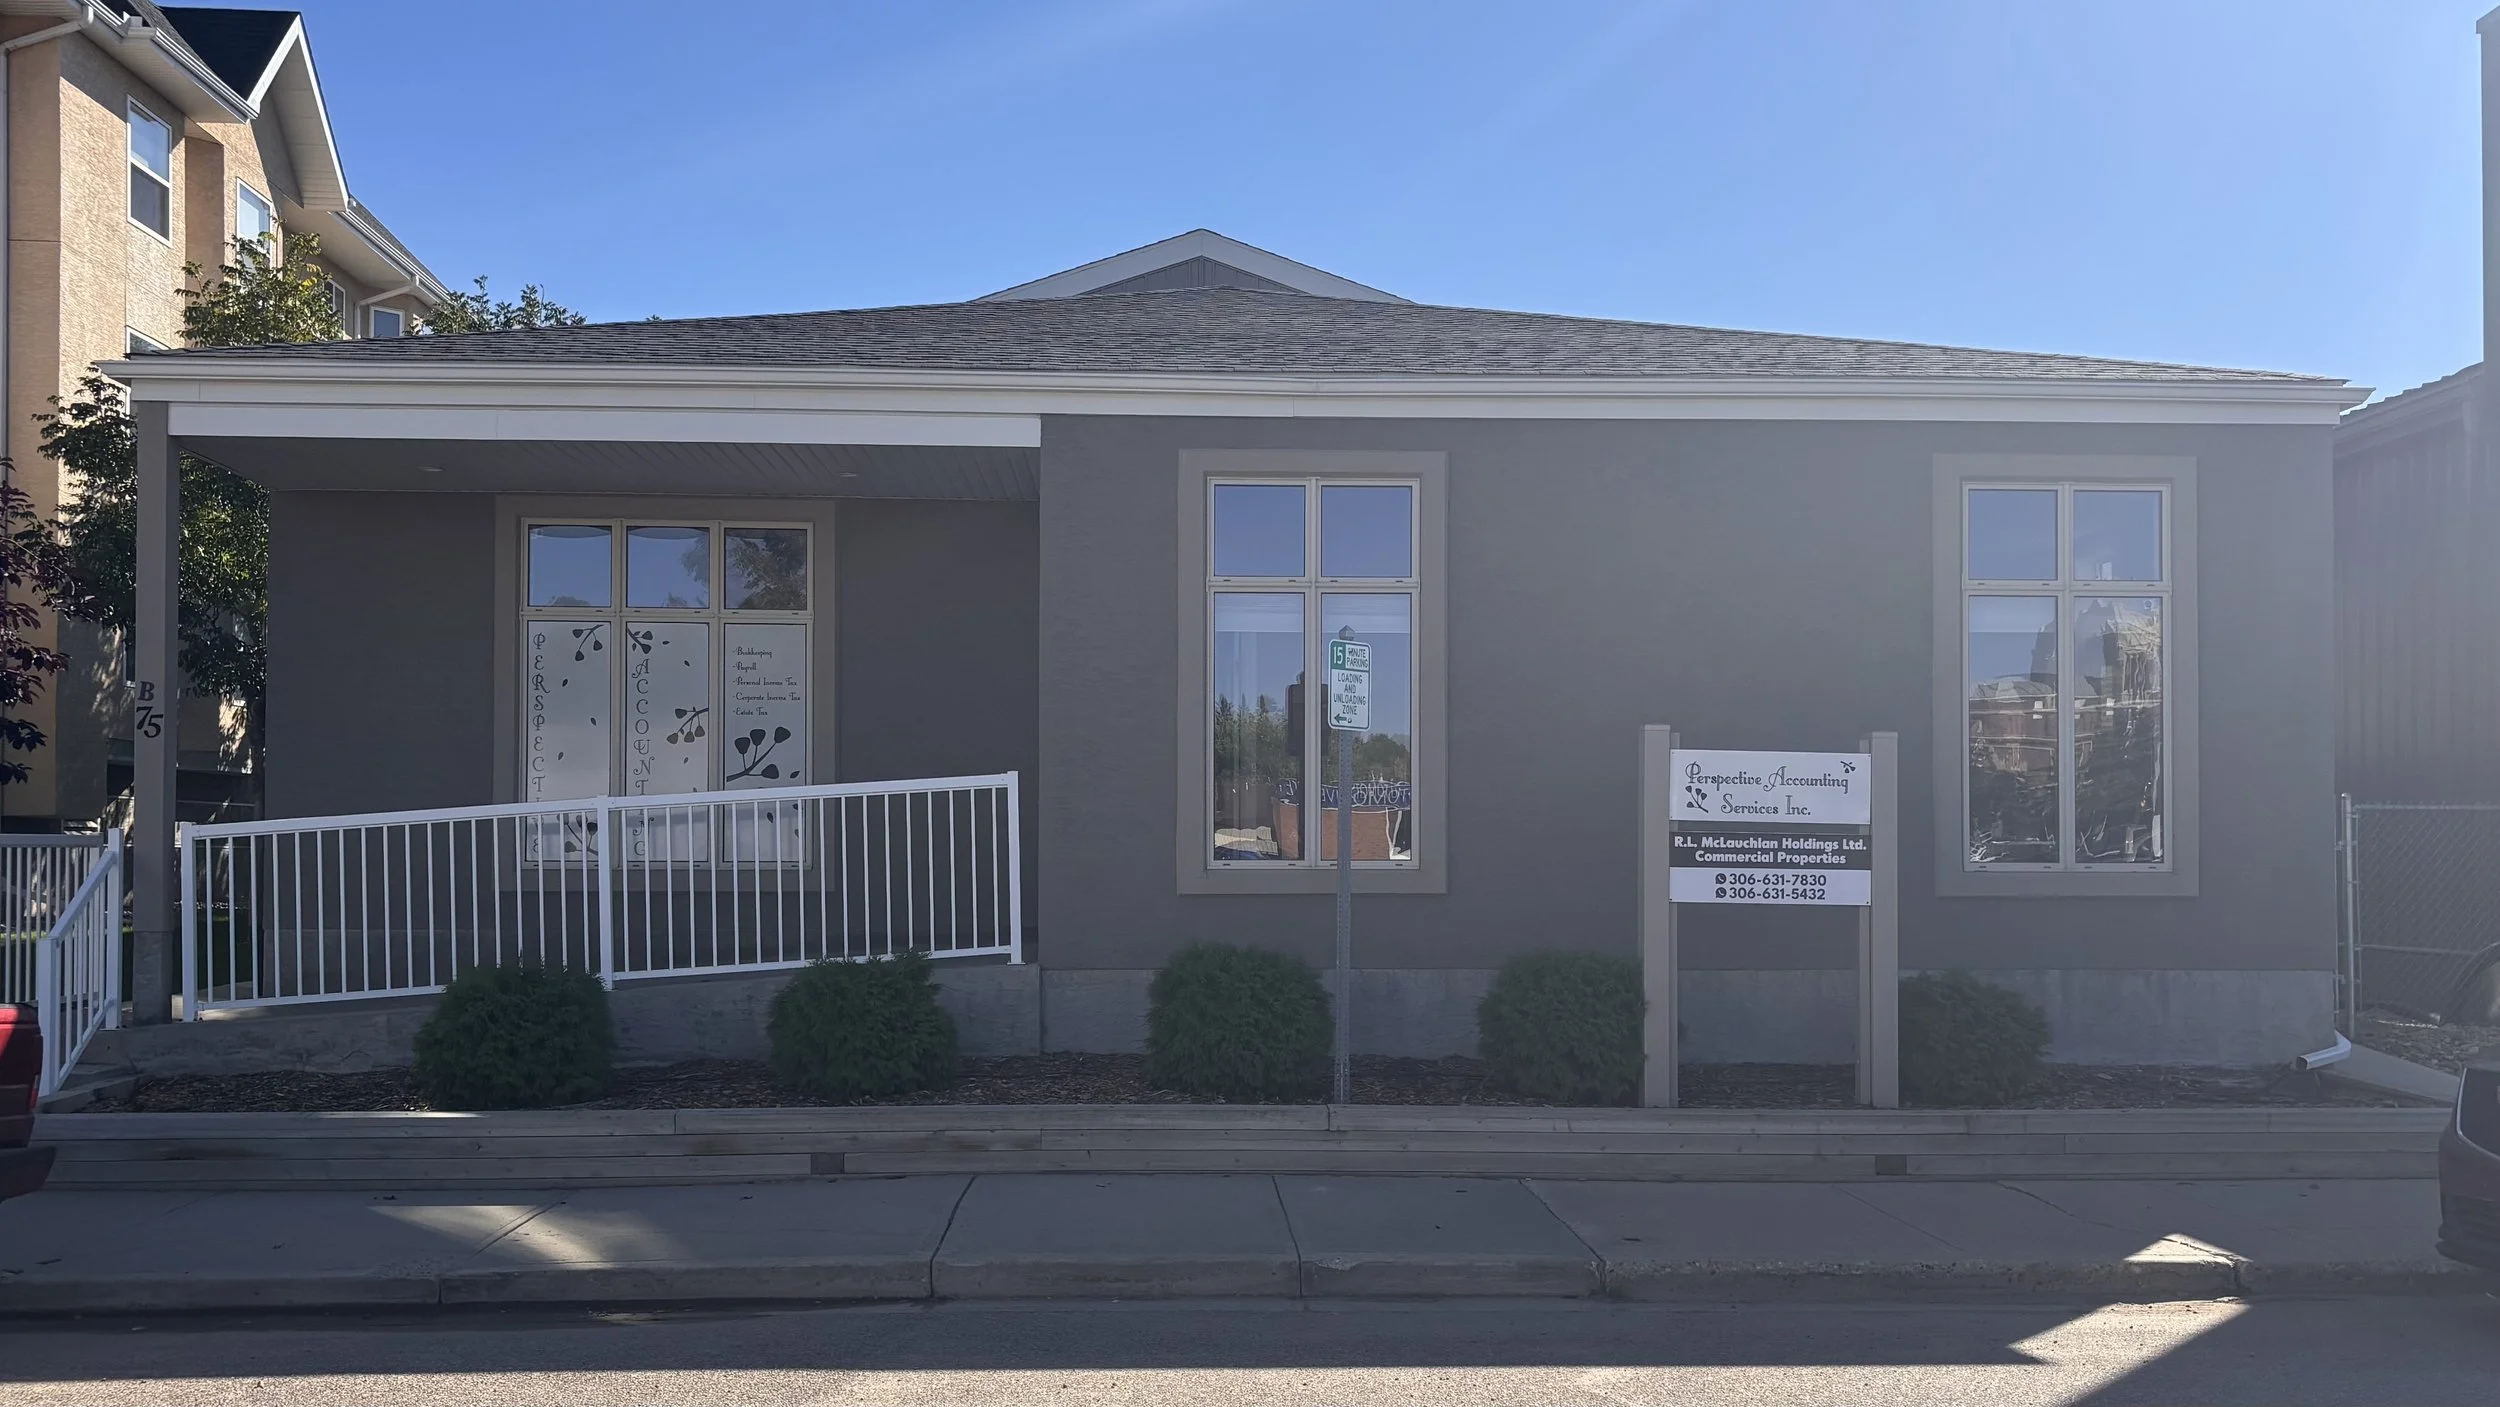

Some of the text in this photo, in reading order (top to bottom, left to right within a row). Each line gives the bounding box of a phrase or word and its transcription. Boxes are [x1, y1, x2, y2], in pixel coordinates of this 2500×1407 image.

[1333, 646, 1343, 665] 15
[1348, 647, 1366, 659] MINUTE
[1346, 657, 1368, 668] PARKING
[1338, 672, 1363, 684] LOADING
[137, 680, 155, 701] B
[1344, 684, 1356, 694] AND
[1333, 693, 1367, 706] UNLOADING
[1342, 704, 1357, 715] ZONE
[136, 706, 164, 738] 75
[1685, 761, 1849, 794] Perspective Accounting
[1720, 793, 1811, 816] Services Inc.
[1674, 835, 1867, 852] R.L. McLauchlan Holdings Ltd.
[1695, 850, 1847, 866] Commercial Properties
[1729, 873, 1827, 886] 306-631-7830
[1729, 887, 1826, 900] 306-631-5432
